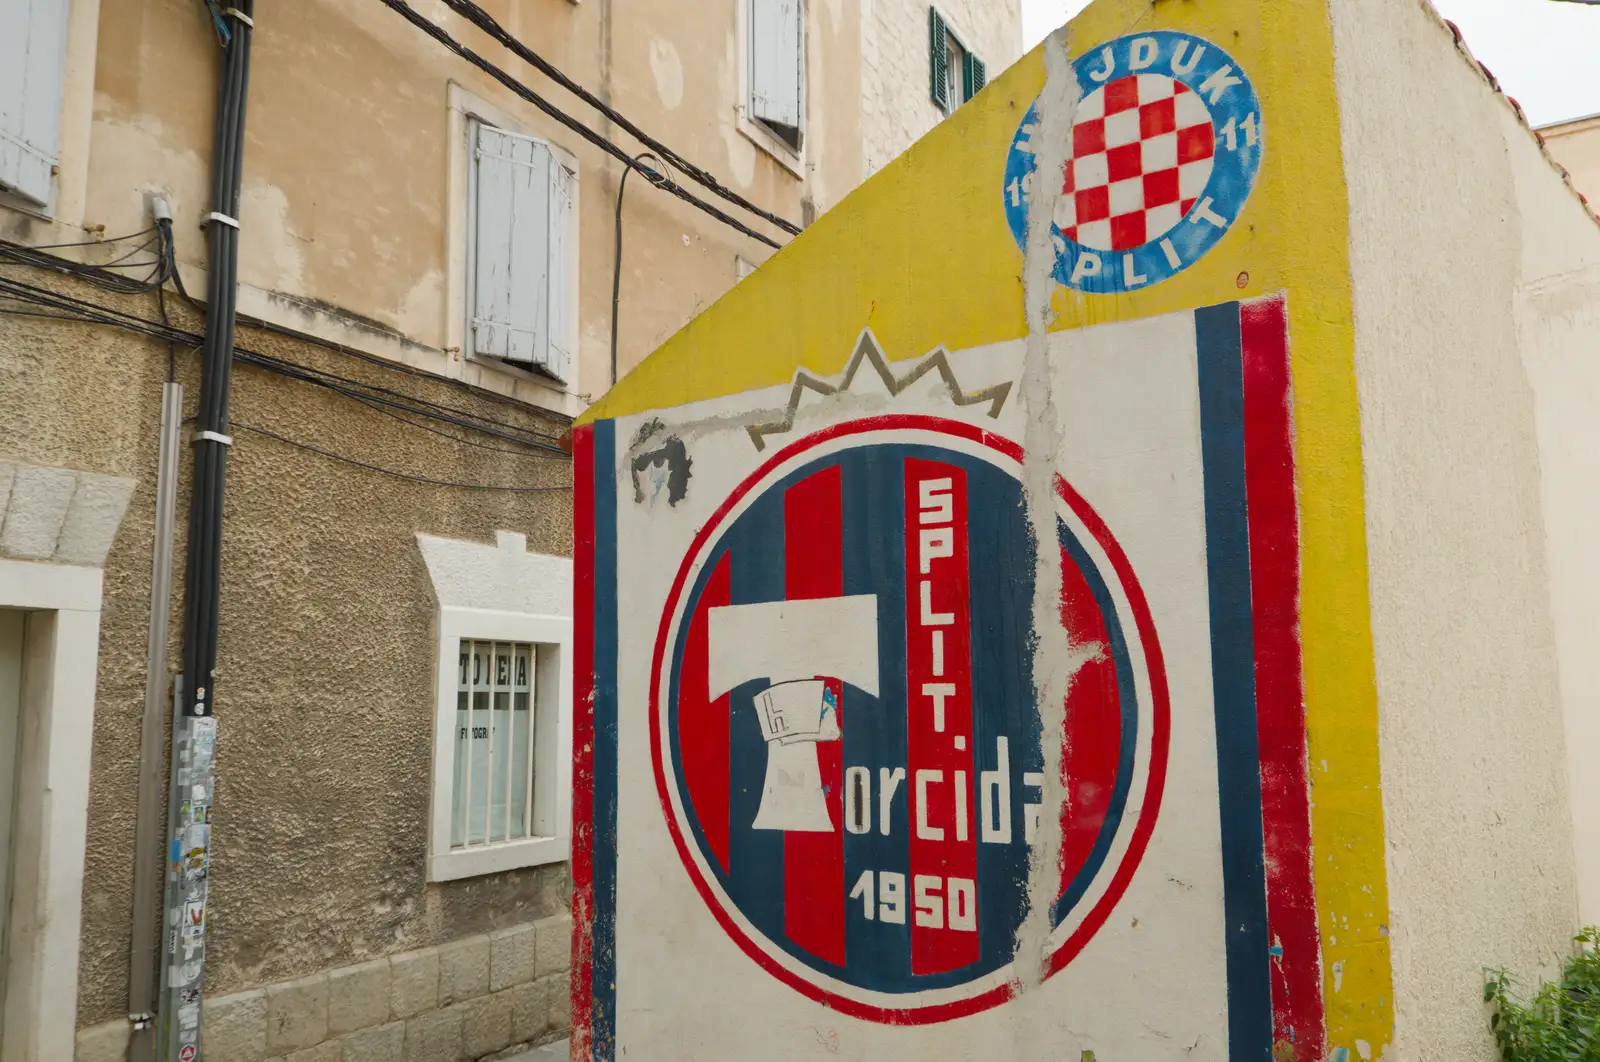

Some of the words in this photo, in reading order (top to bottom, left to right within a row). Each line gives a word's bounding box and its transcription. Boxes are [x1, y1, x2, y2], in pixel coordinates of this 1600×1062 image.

[1220, 112, 1258, 151] 11
[919, 477, 955, 732] SPLIT
[849, 870, 977, 932] 1950
